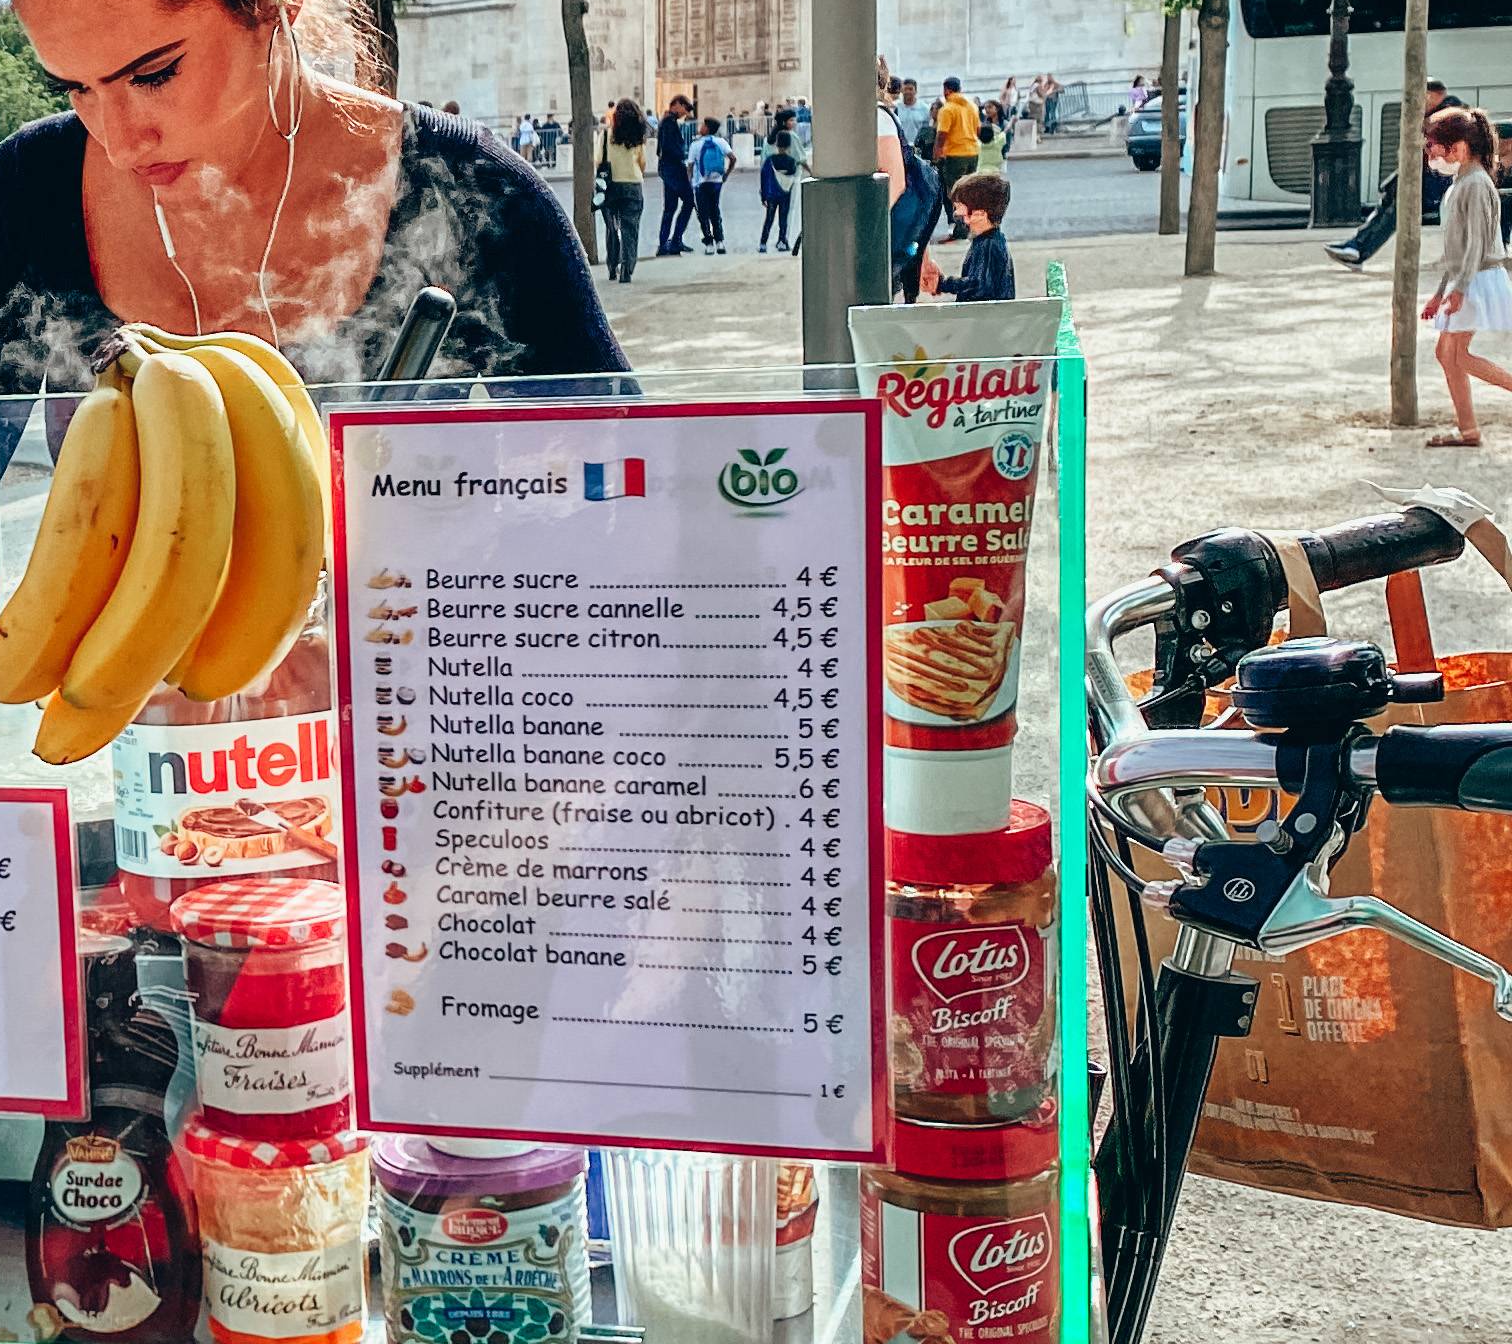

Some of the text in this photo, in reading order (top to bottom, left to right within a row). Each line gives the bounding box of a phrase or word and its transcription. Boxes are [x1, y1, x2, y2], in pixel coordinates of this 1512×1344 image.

[953, 399, 1043, 428] à tartiner
[371, 471, 568, 501] Menu français
[733, 470, 800, 498] bio
[883, 495, 1033, 526] Caramel
[425, 565, 839, 590] Beurre sucre 4 €
[427, 596, 839, 622] Beurre sucre cannelle 4,5 €
[427, 626, 661, 649] Beurre sucre citron
[427, 655, 513, 678] Nutella
[428, 684, 575, 707] Nutella coco
[429, 713, 605, 737] Nutella banane
[148, 720, 338, 795] nutell
[431, 742, 667, 767] Nutella banane coco
[432, 771, 707, 797] Nutella banane caramel
[432, 799, 775, 832] Confiture (fraise ou abricot)
[434, 828, 550, 854] Speculoos
[435, 855, 649, 882] Crème de marrons
[436, 884, 672, 912] Caramel beurre salé
[437, 912, 537, 935] Chocolat
[438, 939, 628, 967] Chocolat banane
[933, 939, 1018, 979] Lotus
[1303, 975, 1347, 997] PLACE
[441, 995, 541, 1025] Fromage
[930, 995, 1013, 1034] Biscoff
[1304, 998, 1322, 1019] DE
[235, 1032, 289, 1059] Bonne
[223, 1065, 309, 1091] Fraises
[393, 1061, 481, 1080] Supplément
[62, 1188, 123, 1209] Choco
[970, 1229, 1045, 1273] Lotus
[239, 1255, 288, 1284] Bonne
[411, 1266, 473, 1286] MARRONS
[967, 1280, 1044, 1326] Biscoff
